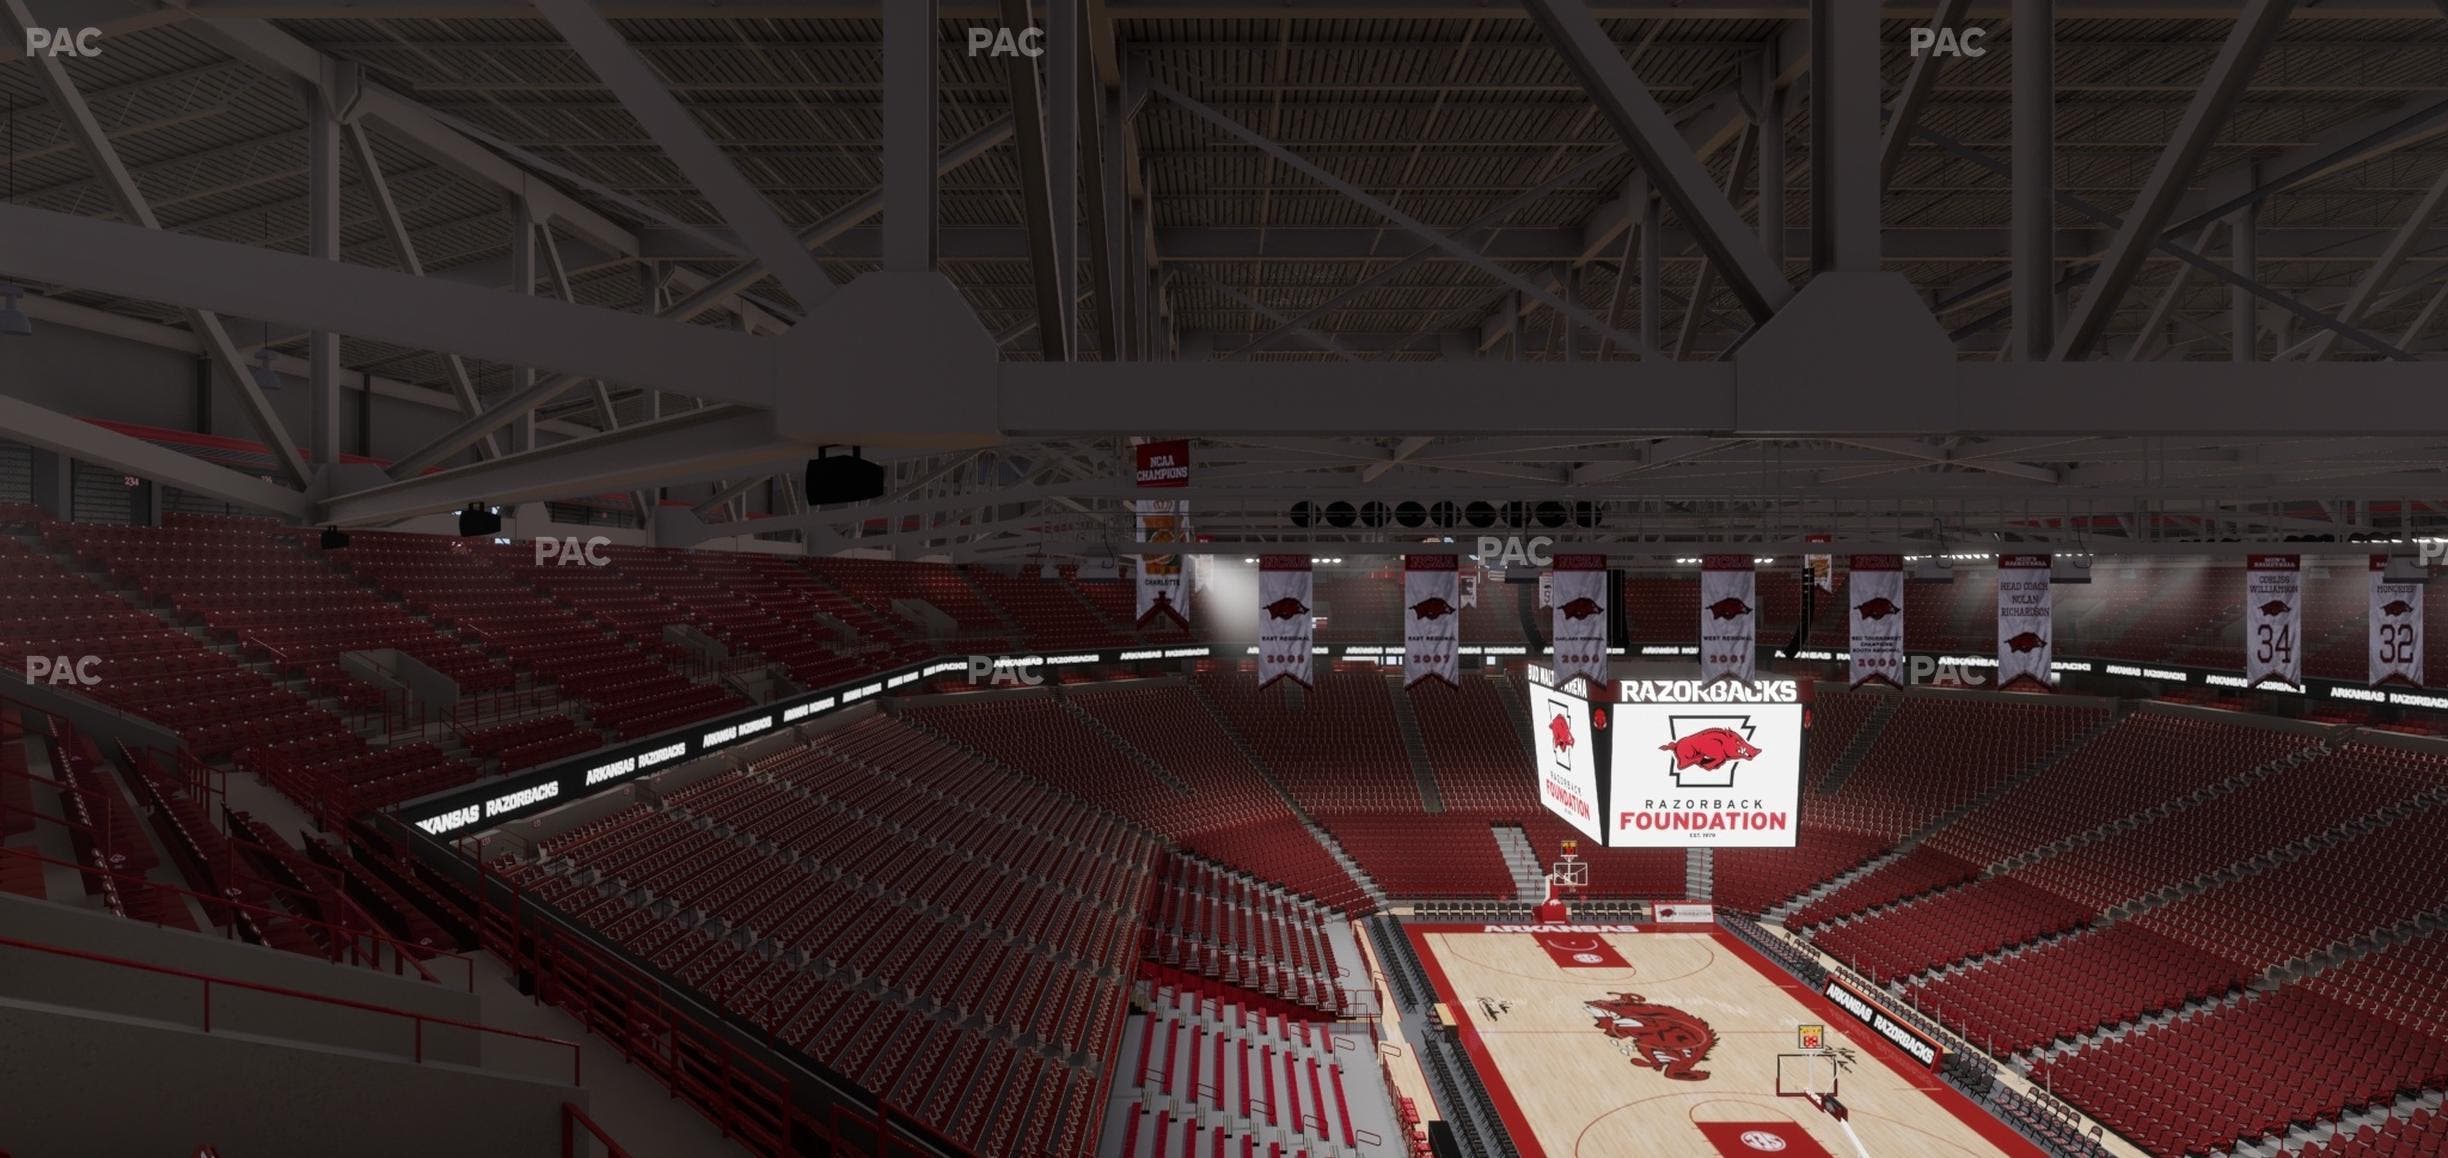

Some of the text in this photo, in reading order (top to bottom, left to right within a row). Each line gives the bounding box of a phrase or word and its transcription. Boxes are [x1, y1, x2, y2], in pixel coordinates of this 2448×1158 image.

[1149, 456, 1174, 468] NCAA
[1136, 467, 1188, 481] CHAMPIONS
[2000, 582, 2049, 591] HEAD COACH
[2012, 595, 2039, 604] NOLAN
[2001, 607, 2050, 617] RICHARDSON
[2257, 624, 2291, 664] 34
[2380, 624, 2414, 664] 32
[2106, 665, 2141, 676] ARKANSAS
[2206, 675, 2247, 688] ARKANSAS
[1620, 680, 1797, 703] RAZORBACKS
[2331, 687, 2385, 702] ARKANSAS
[703, 726, 737, 748] ARKANSAS
[586, 742, 686, 786] ARKANSAS RAZORBACKS
[486, 781, 560, 817] RAZORBACKS
[1546, 779, 1590, 821] FOUNDATION
[1646, 799, 1763, 809] RAZORBACK
[1620, 812, 1787, 830] FOUNDATION
[1484, 925, 1639, 934] ARKANSAS
[1826, 983, 1873, 1023] ARKANSAS
[1873, 1013, 1935, 1065] RAZORBACKS
